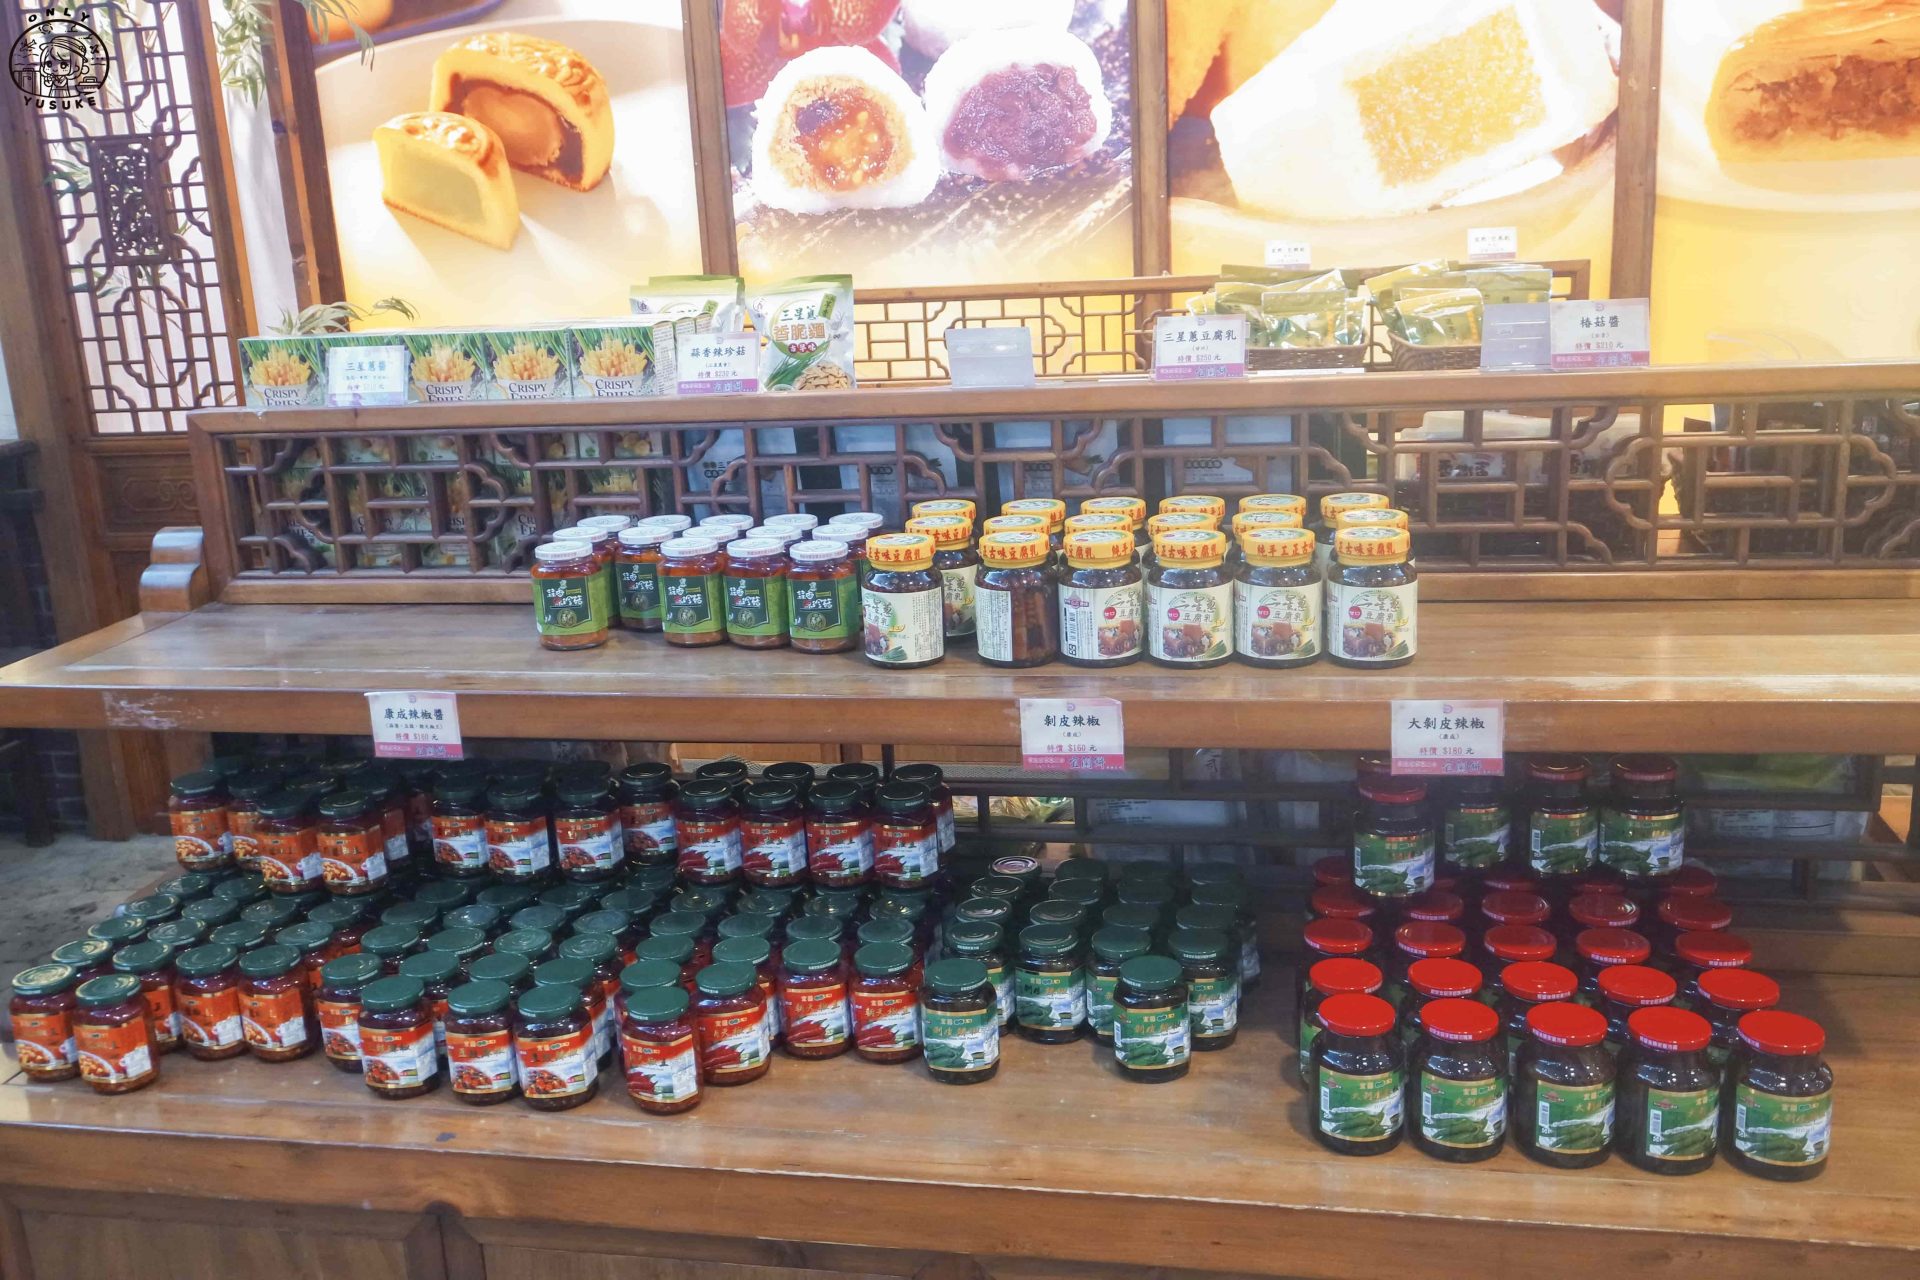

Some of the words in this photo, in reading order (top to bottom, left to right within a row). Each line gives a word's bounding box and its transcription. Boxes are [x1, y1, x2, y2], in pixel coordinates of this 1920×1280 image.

[426, 384, 463, 395] CRISPY
[508, 382, 547, 393] CRISPY
[595, 378, 634, 391] CRISPY
[264, 388, 300, 398] CRISPY
[384, 708, 443, 720] 康成辣椒醬
[1044, 714, 1100, 727] 剝皮辣椒
[1407, 717, 1485, 730] 大剝皮辣椒
[1047, 744, 1063, 753] 特價
[1068, 744, 1086, 752] $160
[1089, 744, 1097, 752] 元
[1420, 747, 1437, 755] 特價
[1466, 747, 1474, 755] 元
